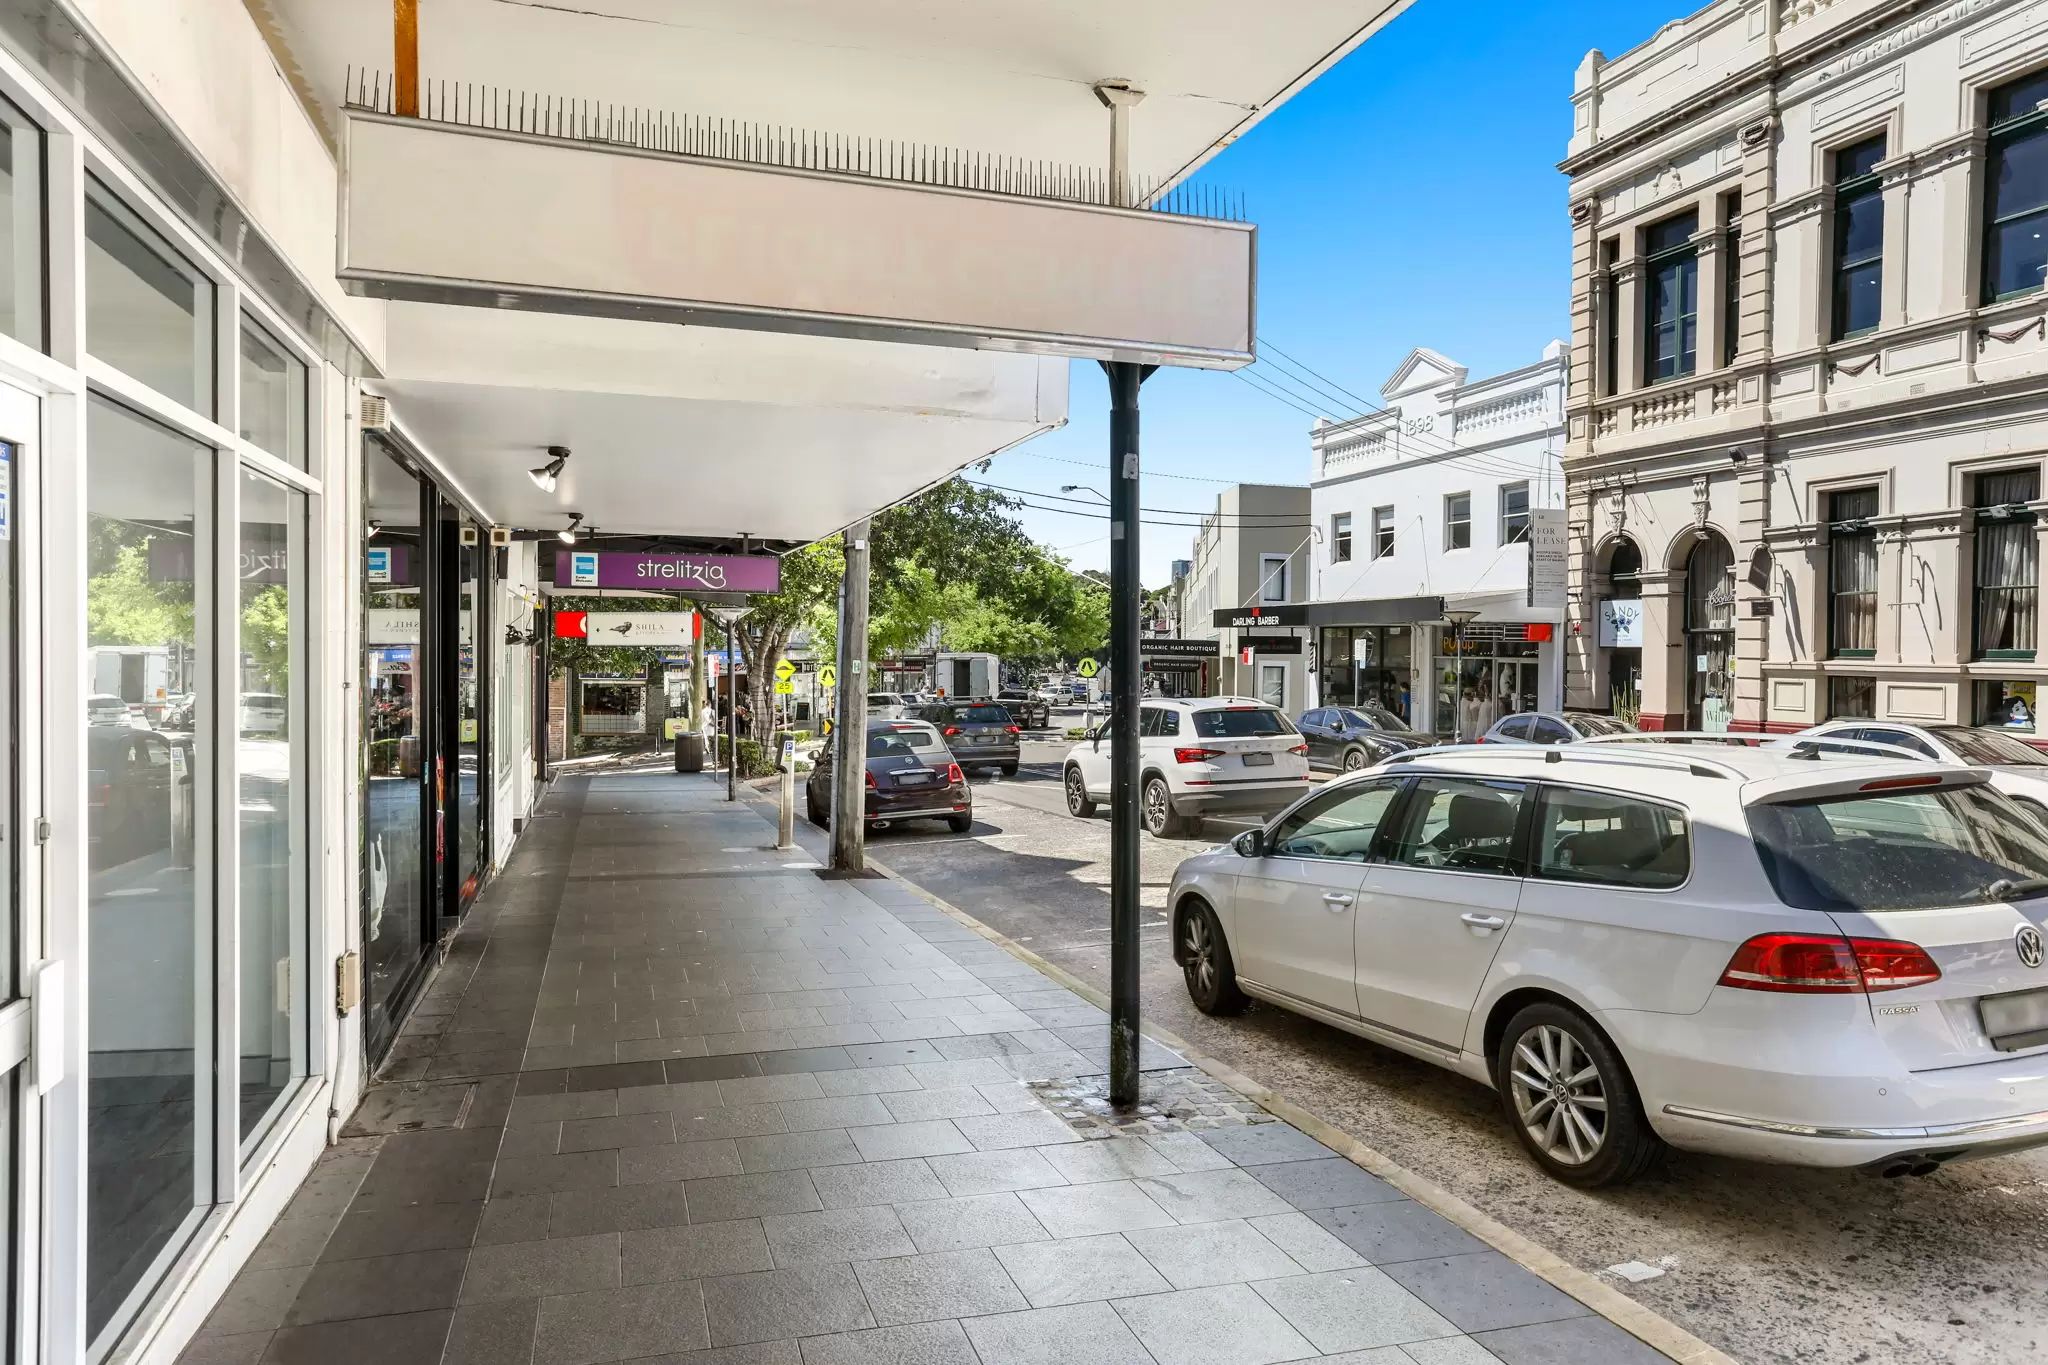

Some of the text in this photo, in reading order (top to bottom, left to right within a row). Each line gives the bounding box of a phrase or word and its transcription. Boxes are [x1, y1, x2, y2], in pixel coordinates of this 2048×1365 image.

[1537, 527, 1555, 535] FOR
[1537, 537, 1566, 545] LEASE
[637, 560, 727, 589] strelitzia
[1604, 605, 1640, 621] SANDY
[1232, 615, 1280, 626] DARLING BARBER
[779, 682, 790, 690] 25
[1879, 1005, 1921, 1016] PASSAT
